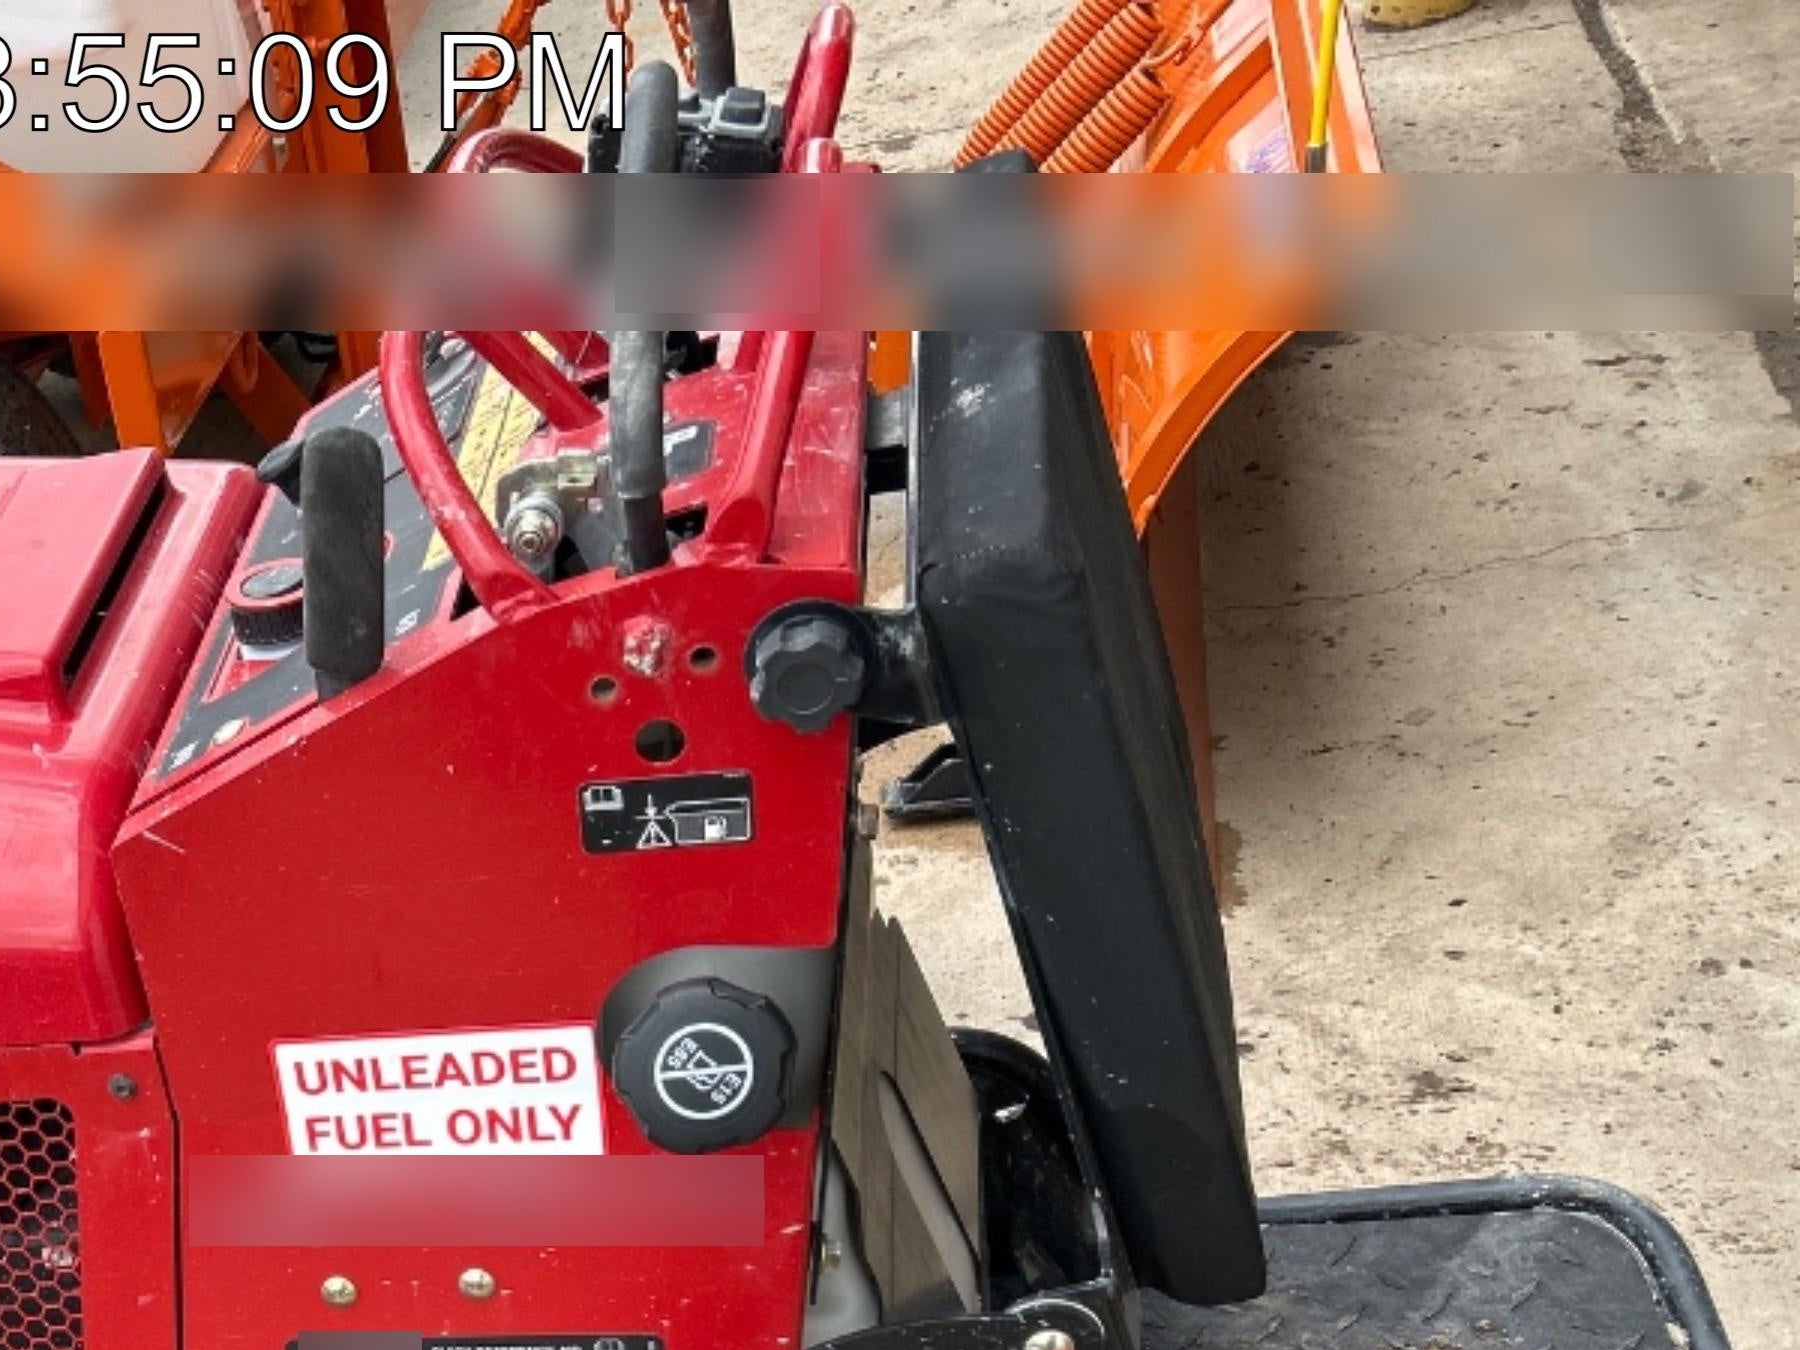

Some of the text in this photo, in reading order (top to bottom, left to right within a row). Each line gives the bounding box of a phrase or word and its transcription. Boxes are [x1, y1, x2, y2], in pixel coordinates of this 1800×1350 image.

[293, 1046, 578, 1096] UNLEADED
[305, 1103, 583, 1153] FUEL ONLY
